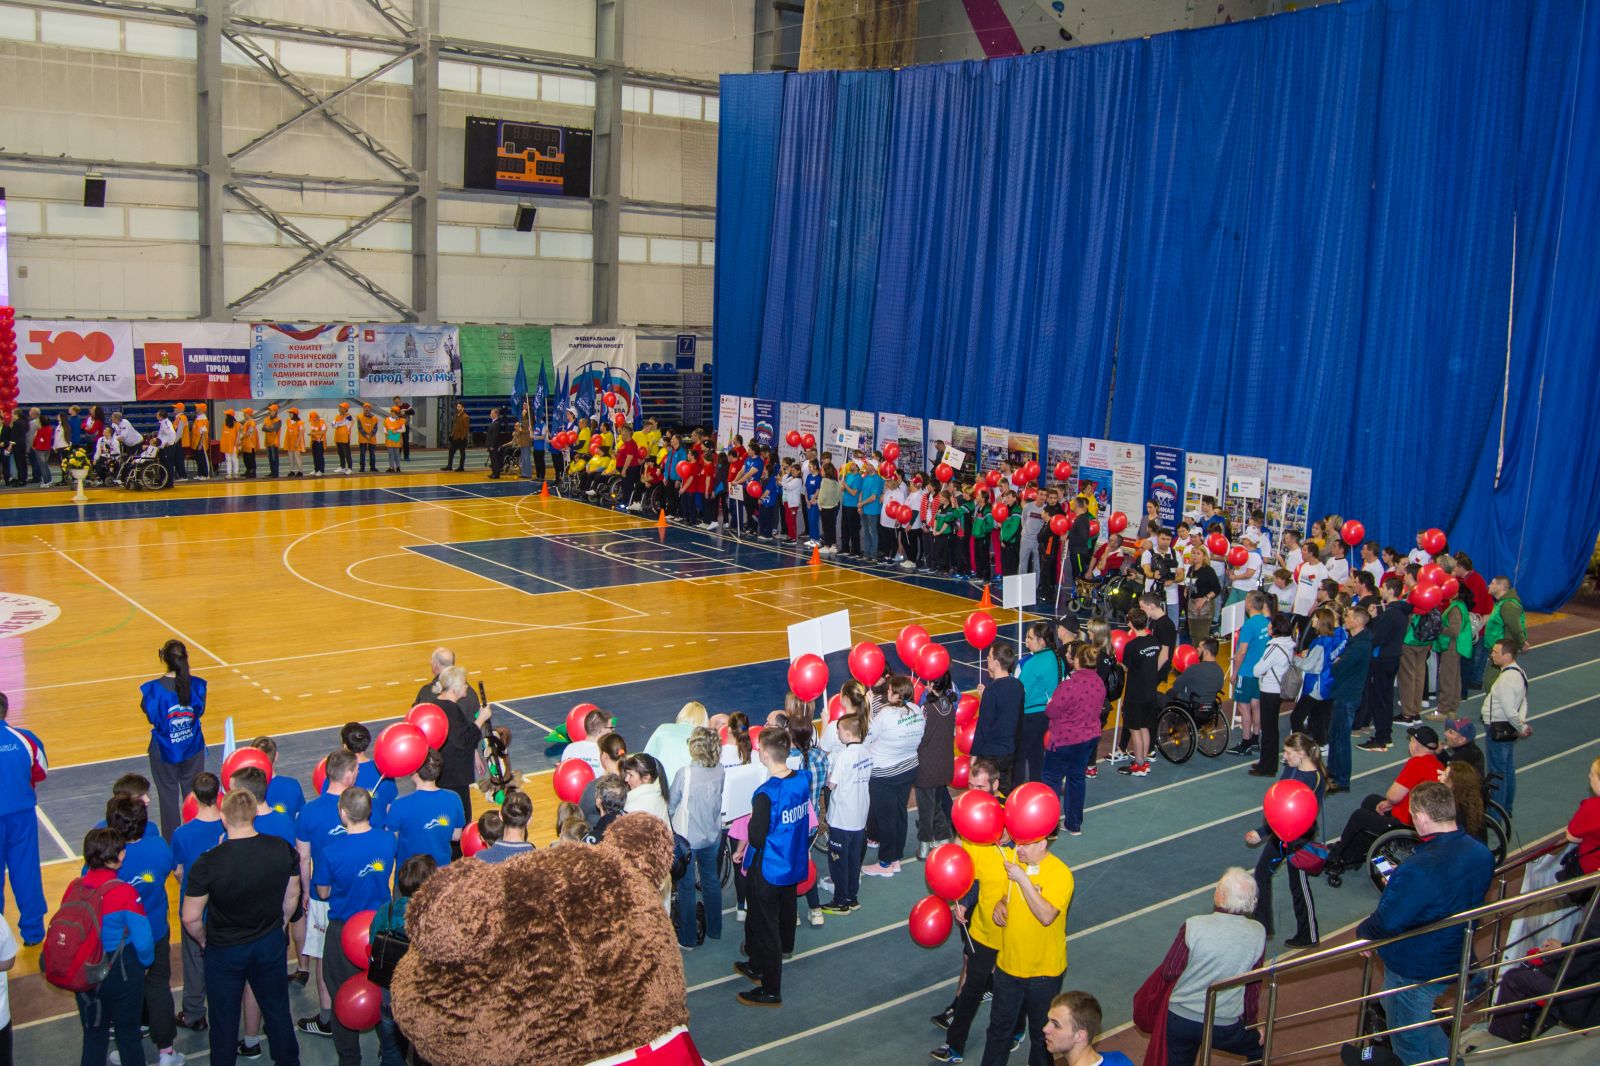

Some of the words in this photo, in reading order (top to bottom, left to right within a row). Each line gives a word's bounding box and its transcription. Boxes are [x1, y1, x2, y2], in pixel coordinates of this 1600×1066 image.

[683, 339, 691, 350] 7
[25, 331, 115, 371] 300
[188, 354, 246, 364] АДМИНИСТРАЦИЯ
[206, 364, 231, 374] ГОРОДА
[55, 374, 95, 382] ТРИСТА
[97, 374, 117, 382] ЛЕТ
[208, 374, 230, 383] ПЕРМИ
[367, 373, 403, 385] ГОРОД
[411, 372, 433, 383] ЭТО
[55, 386, 92, 394] ПЕРМИ
